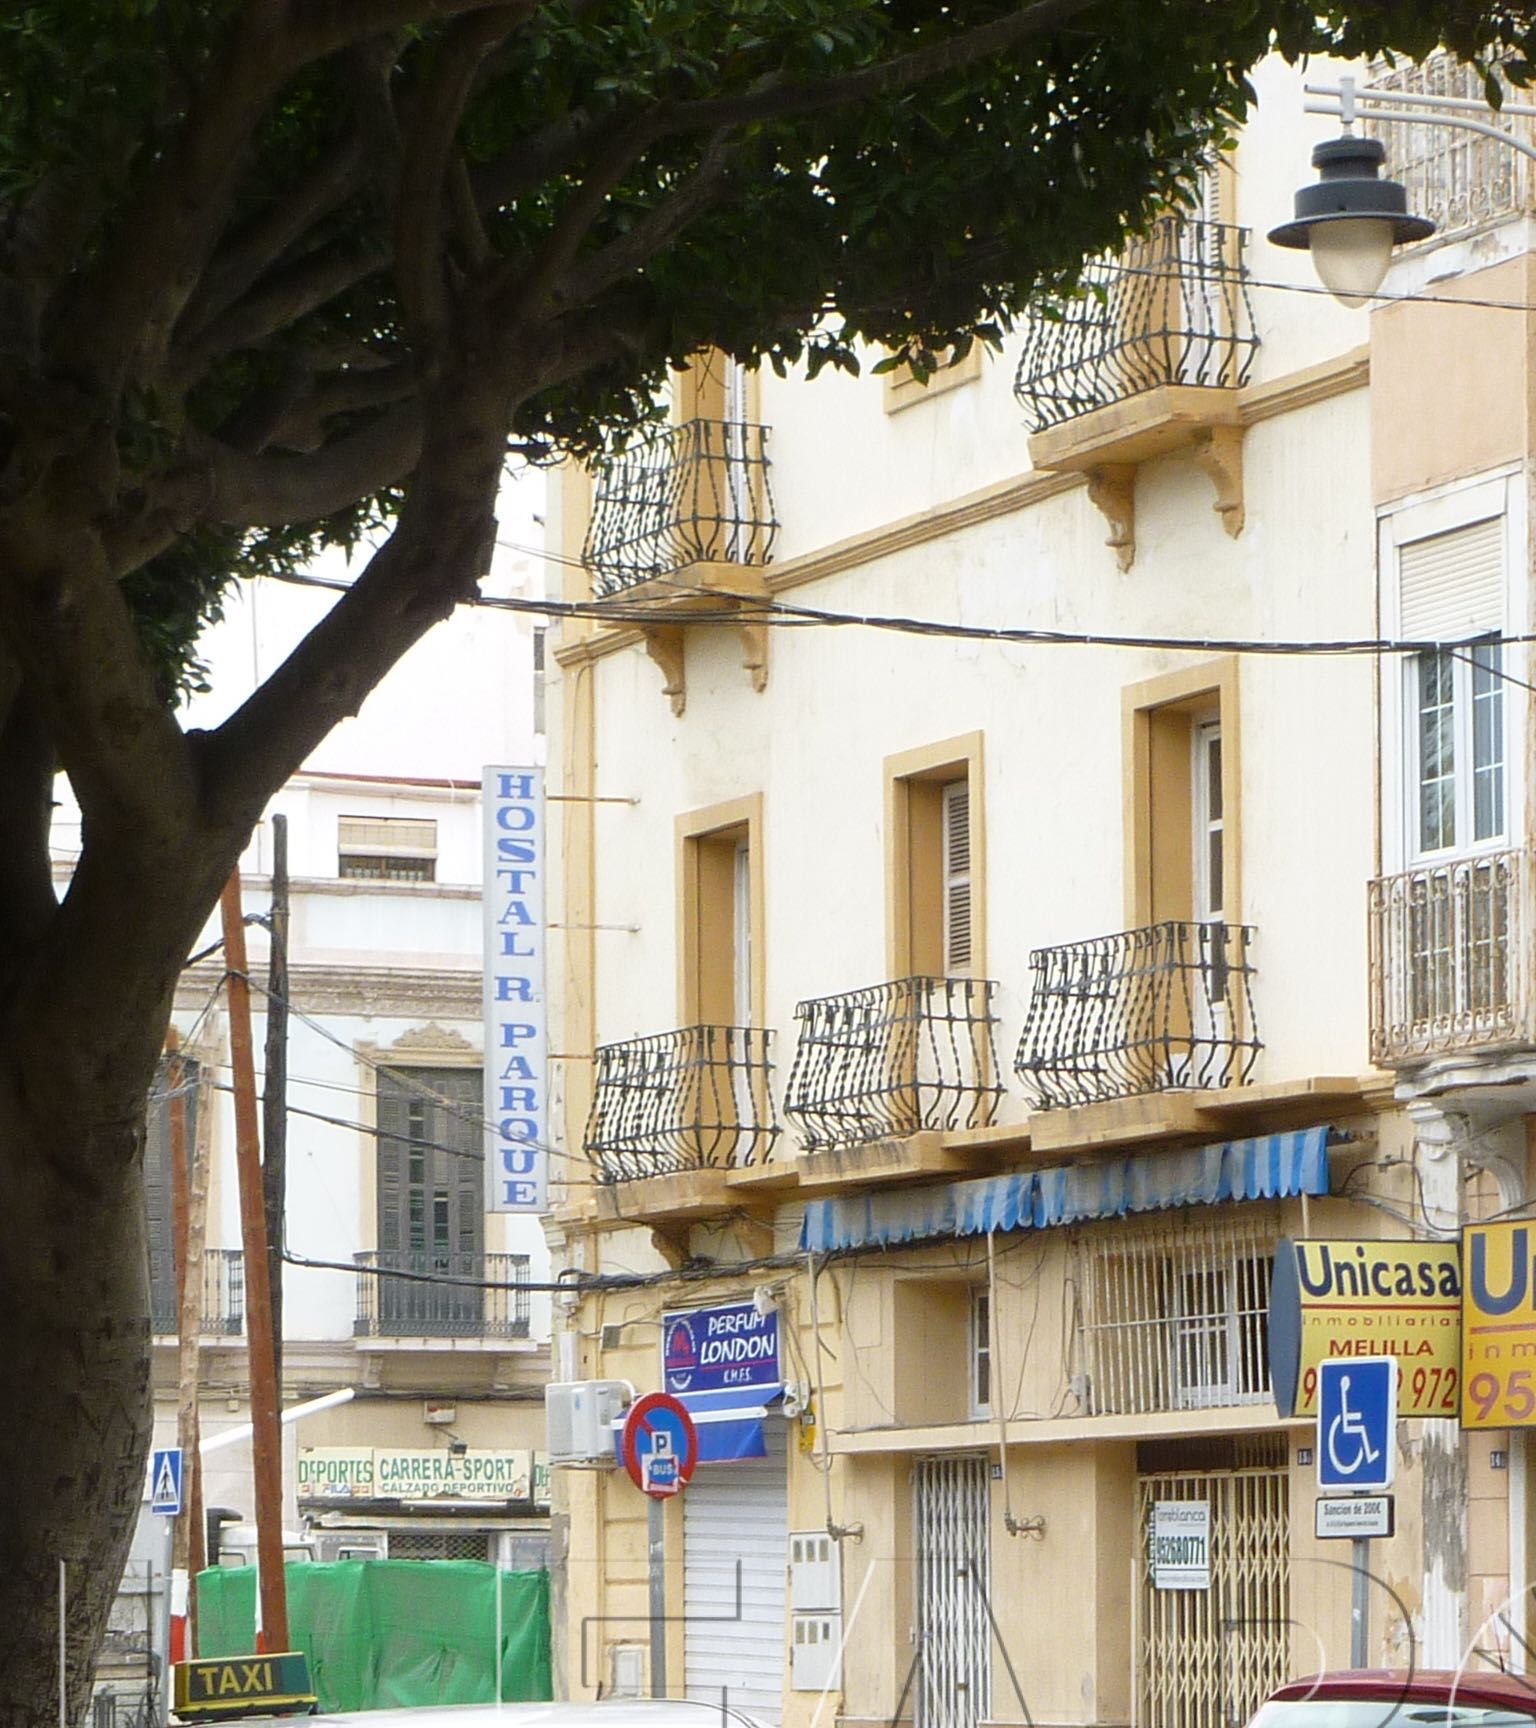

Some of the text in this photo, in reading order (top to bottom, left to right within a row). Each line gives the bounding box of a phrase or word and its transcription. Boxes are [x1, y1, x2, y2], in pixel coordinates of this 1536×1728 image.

[496, 773, 537, 957] HOSTAL
[499, 1023, 539, 1206] PARQUE
[1296, 1244, 1462, 1298] Unicasa
[700, 1333, 775, 1365] LONDON
[1329, 1339, 1434, 1357] MELILLA
[1412, 1367, 1458, 1409] 972
[655, 1434, 668, 1454] P
[652, 1463, 674, 1476] BUS
[382, 1482, 514, 1494] CALZADO DEPORTIVO
[197, 1662, 274, 1696] TAXI
